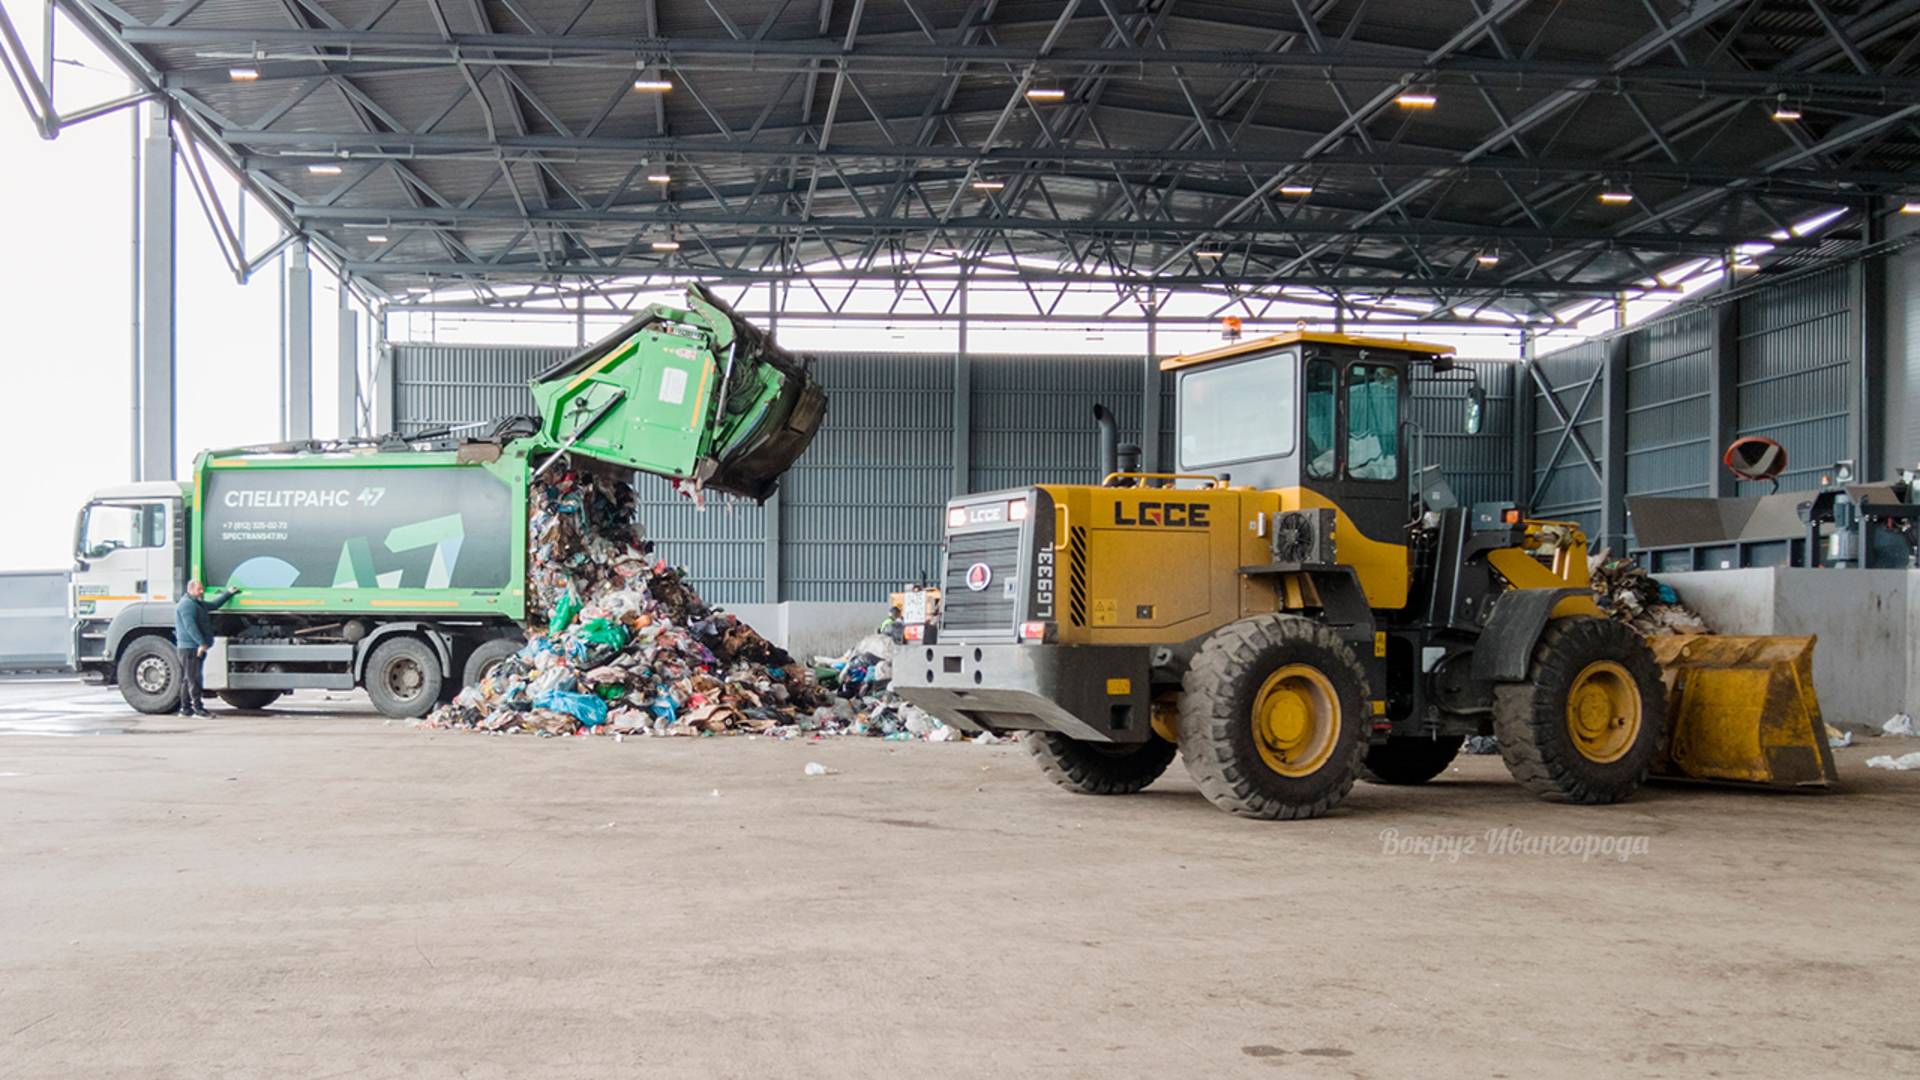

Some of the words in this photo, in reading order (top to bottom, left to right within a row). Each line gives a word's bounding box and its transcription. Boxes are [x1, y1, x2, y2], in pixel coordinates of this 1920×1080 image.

[224, 490, 350, 508] СПЕЦТРАНС
[356, 487, 386, 507] 47
[1037, 541, 1053, 617] LG933L
